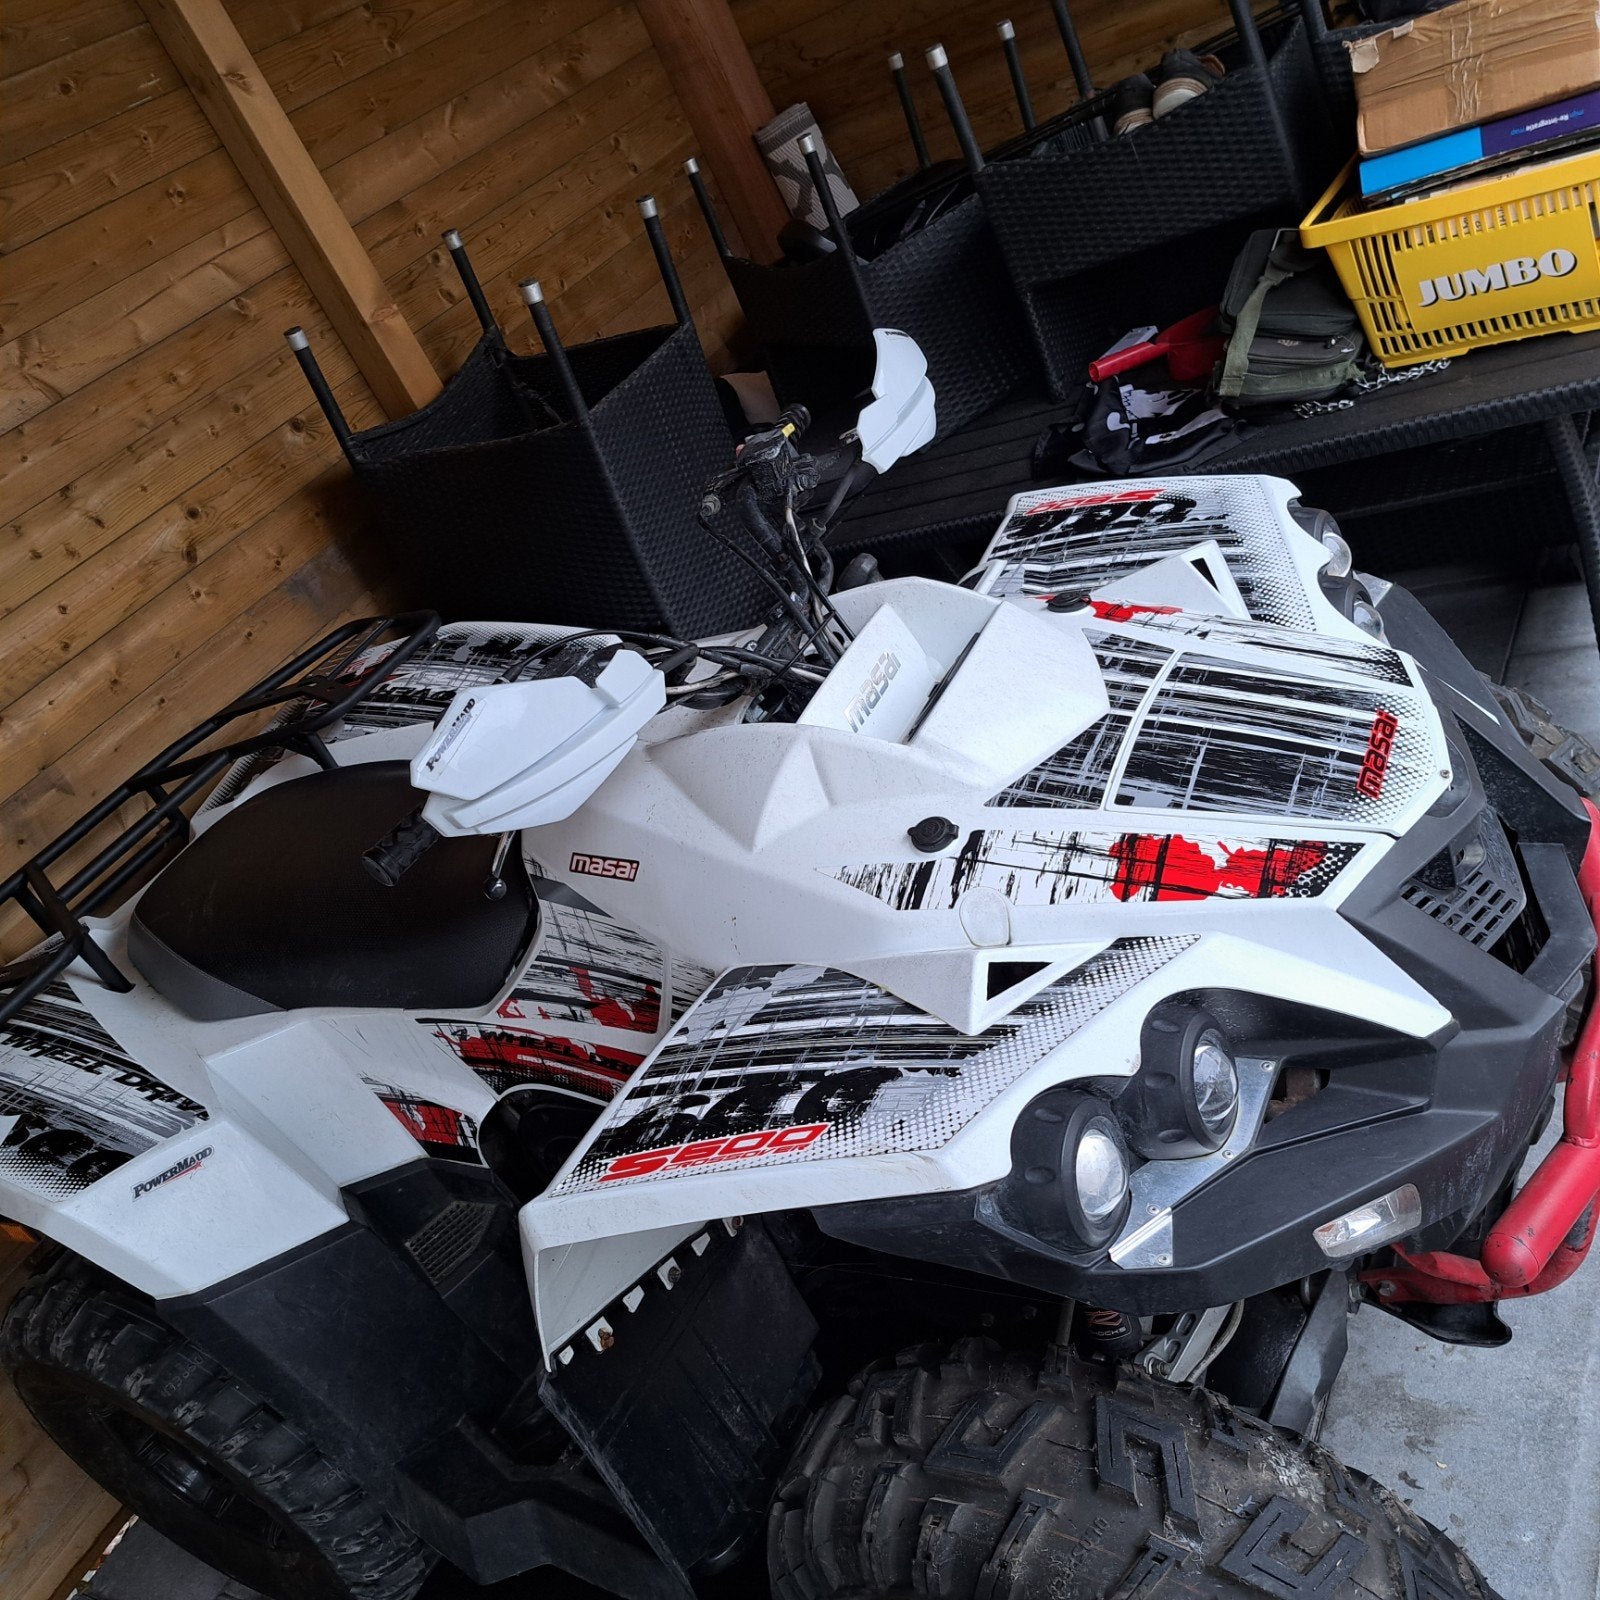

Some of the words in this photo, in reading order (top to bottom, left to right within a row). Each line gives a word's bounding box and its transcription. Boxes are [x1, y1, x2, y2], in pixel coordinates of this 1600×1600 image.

[1418, 249, 1578, 307] JUMBO
[843, 652, 901, 733] masai
[1356, 709, 1398, 799] masai
[570, 854, 639, 880] masai
[1, 1033, 107, 1076] WHEEL
[661, 1143, 813, 1172] CROSSOVER
